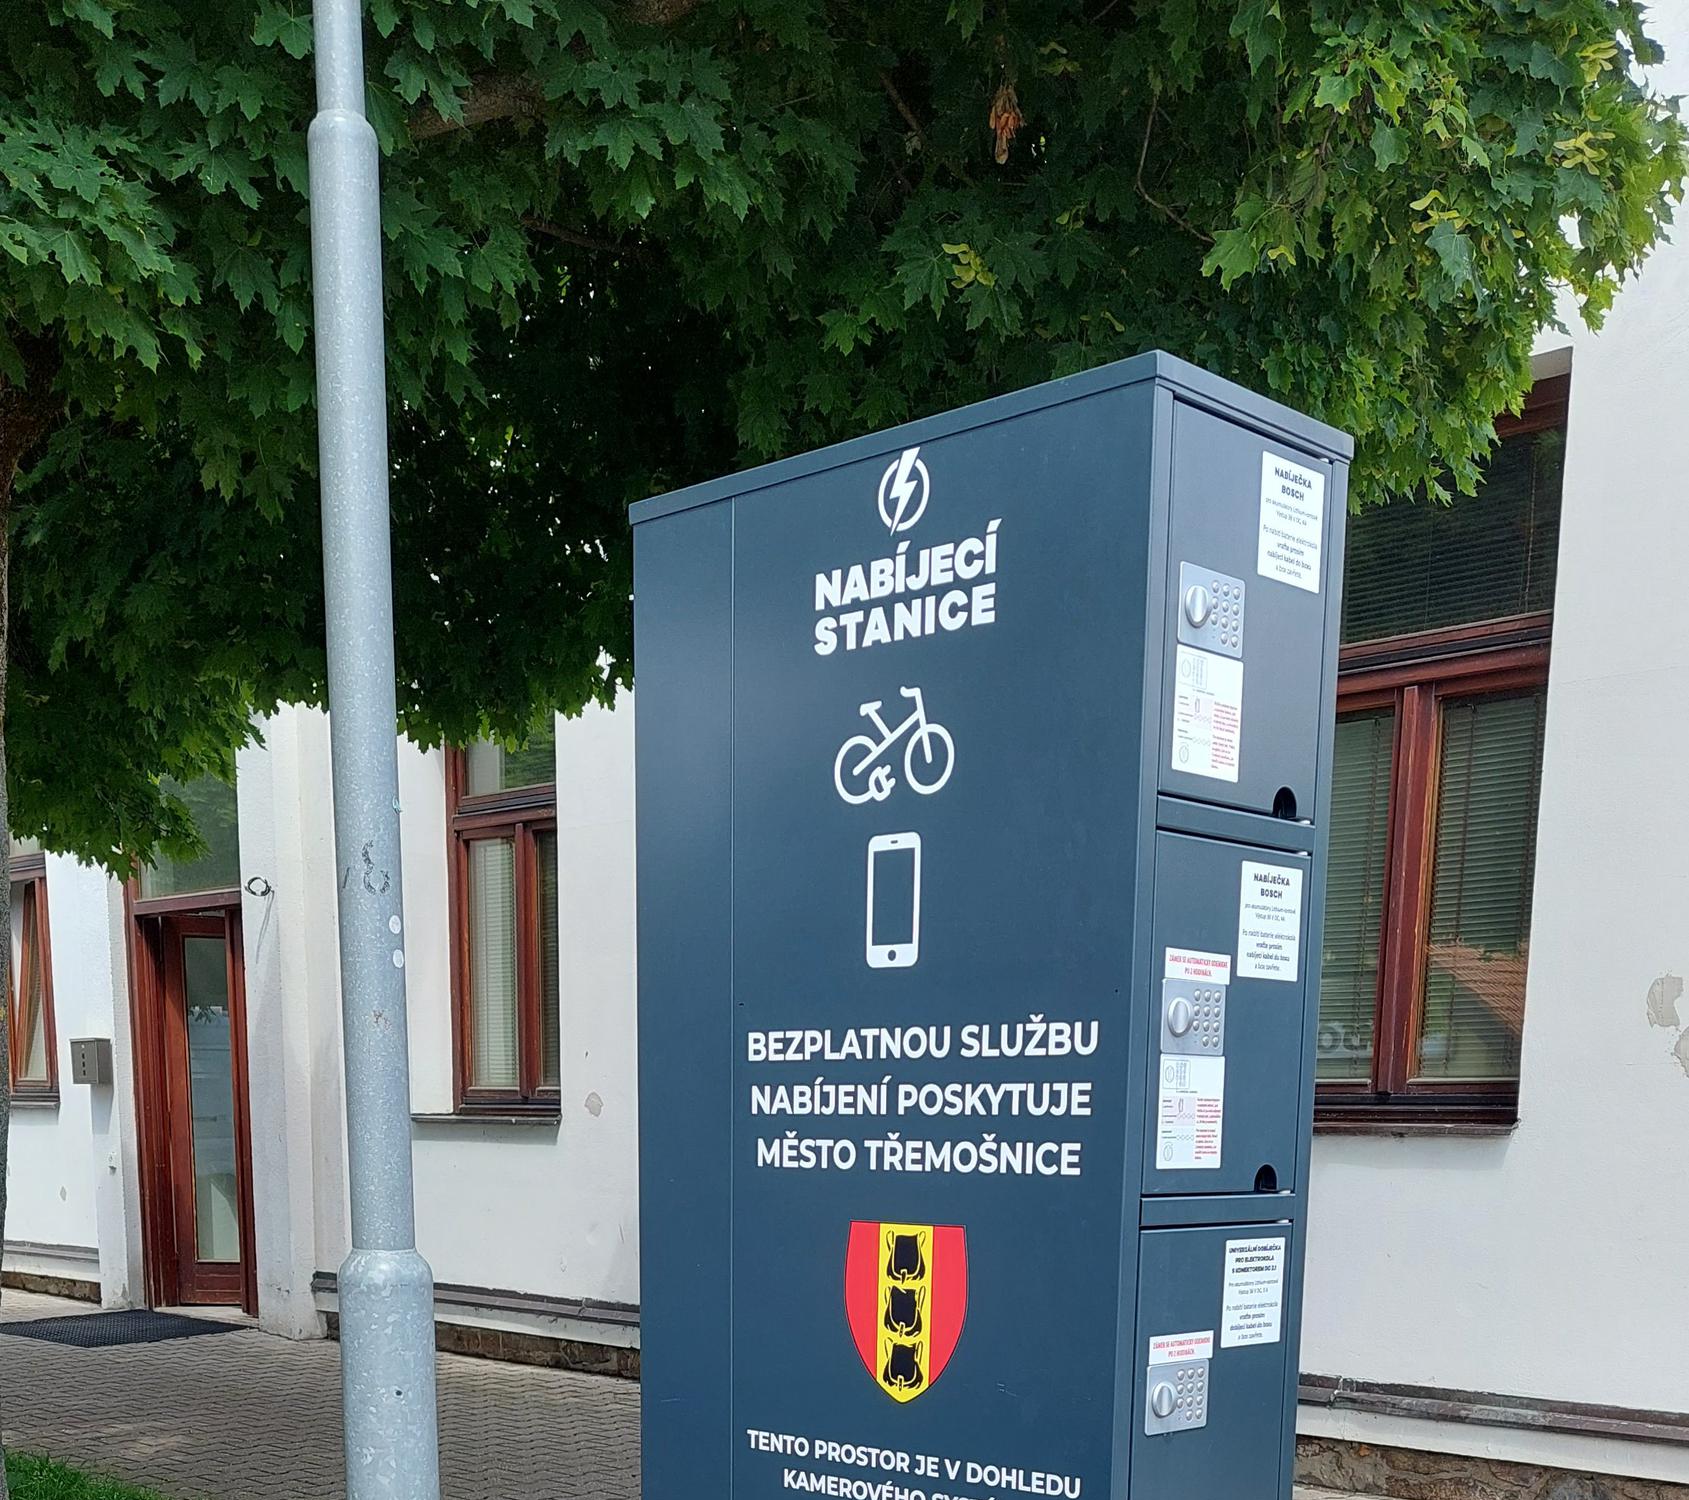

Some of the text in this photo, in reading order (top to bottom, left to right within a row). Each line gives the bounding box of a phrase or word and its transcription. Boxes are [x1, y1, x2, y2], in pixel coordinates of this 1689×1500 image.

[1275, 467, 1312, 489] NABÍJEČKA
[1281, 485, 1304, 501] BOSCH
[815, 518, 1002, 611] NABÍJECÍ
[814, 582, 996, 656] STANICE
[1254, 873, 1290, 886] NABÍJEČKA
[1260, 888, 1283, 899] BOSCH
[748, 1014, 1100, 1062] BEZPLATNOU SLUŽBU
[751, 1075, 1092, 1116] NABÍJENÍ POSKYTUJE
[756, 1131, 1081, 1176] MĚSTO TŘEMOŠNICE
[747, 1429, 1081, 1499] TENTO PROSTOR JE V DOHLEDU
